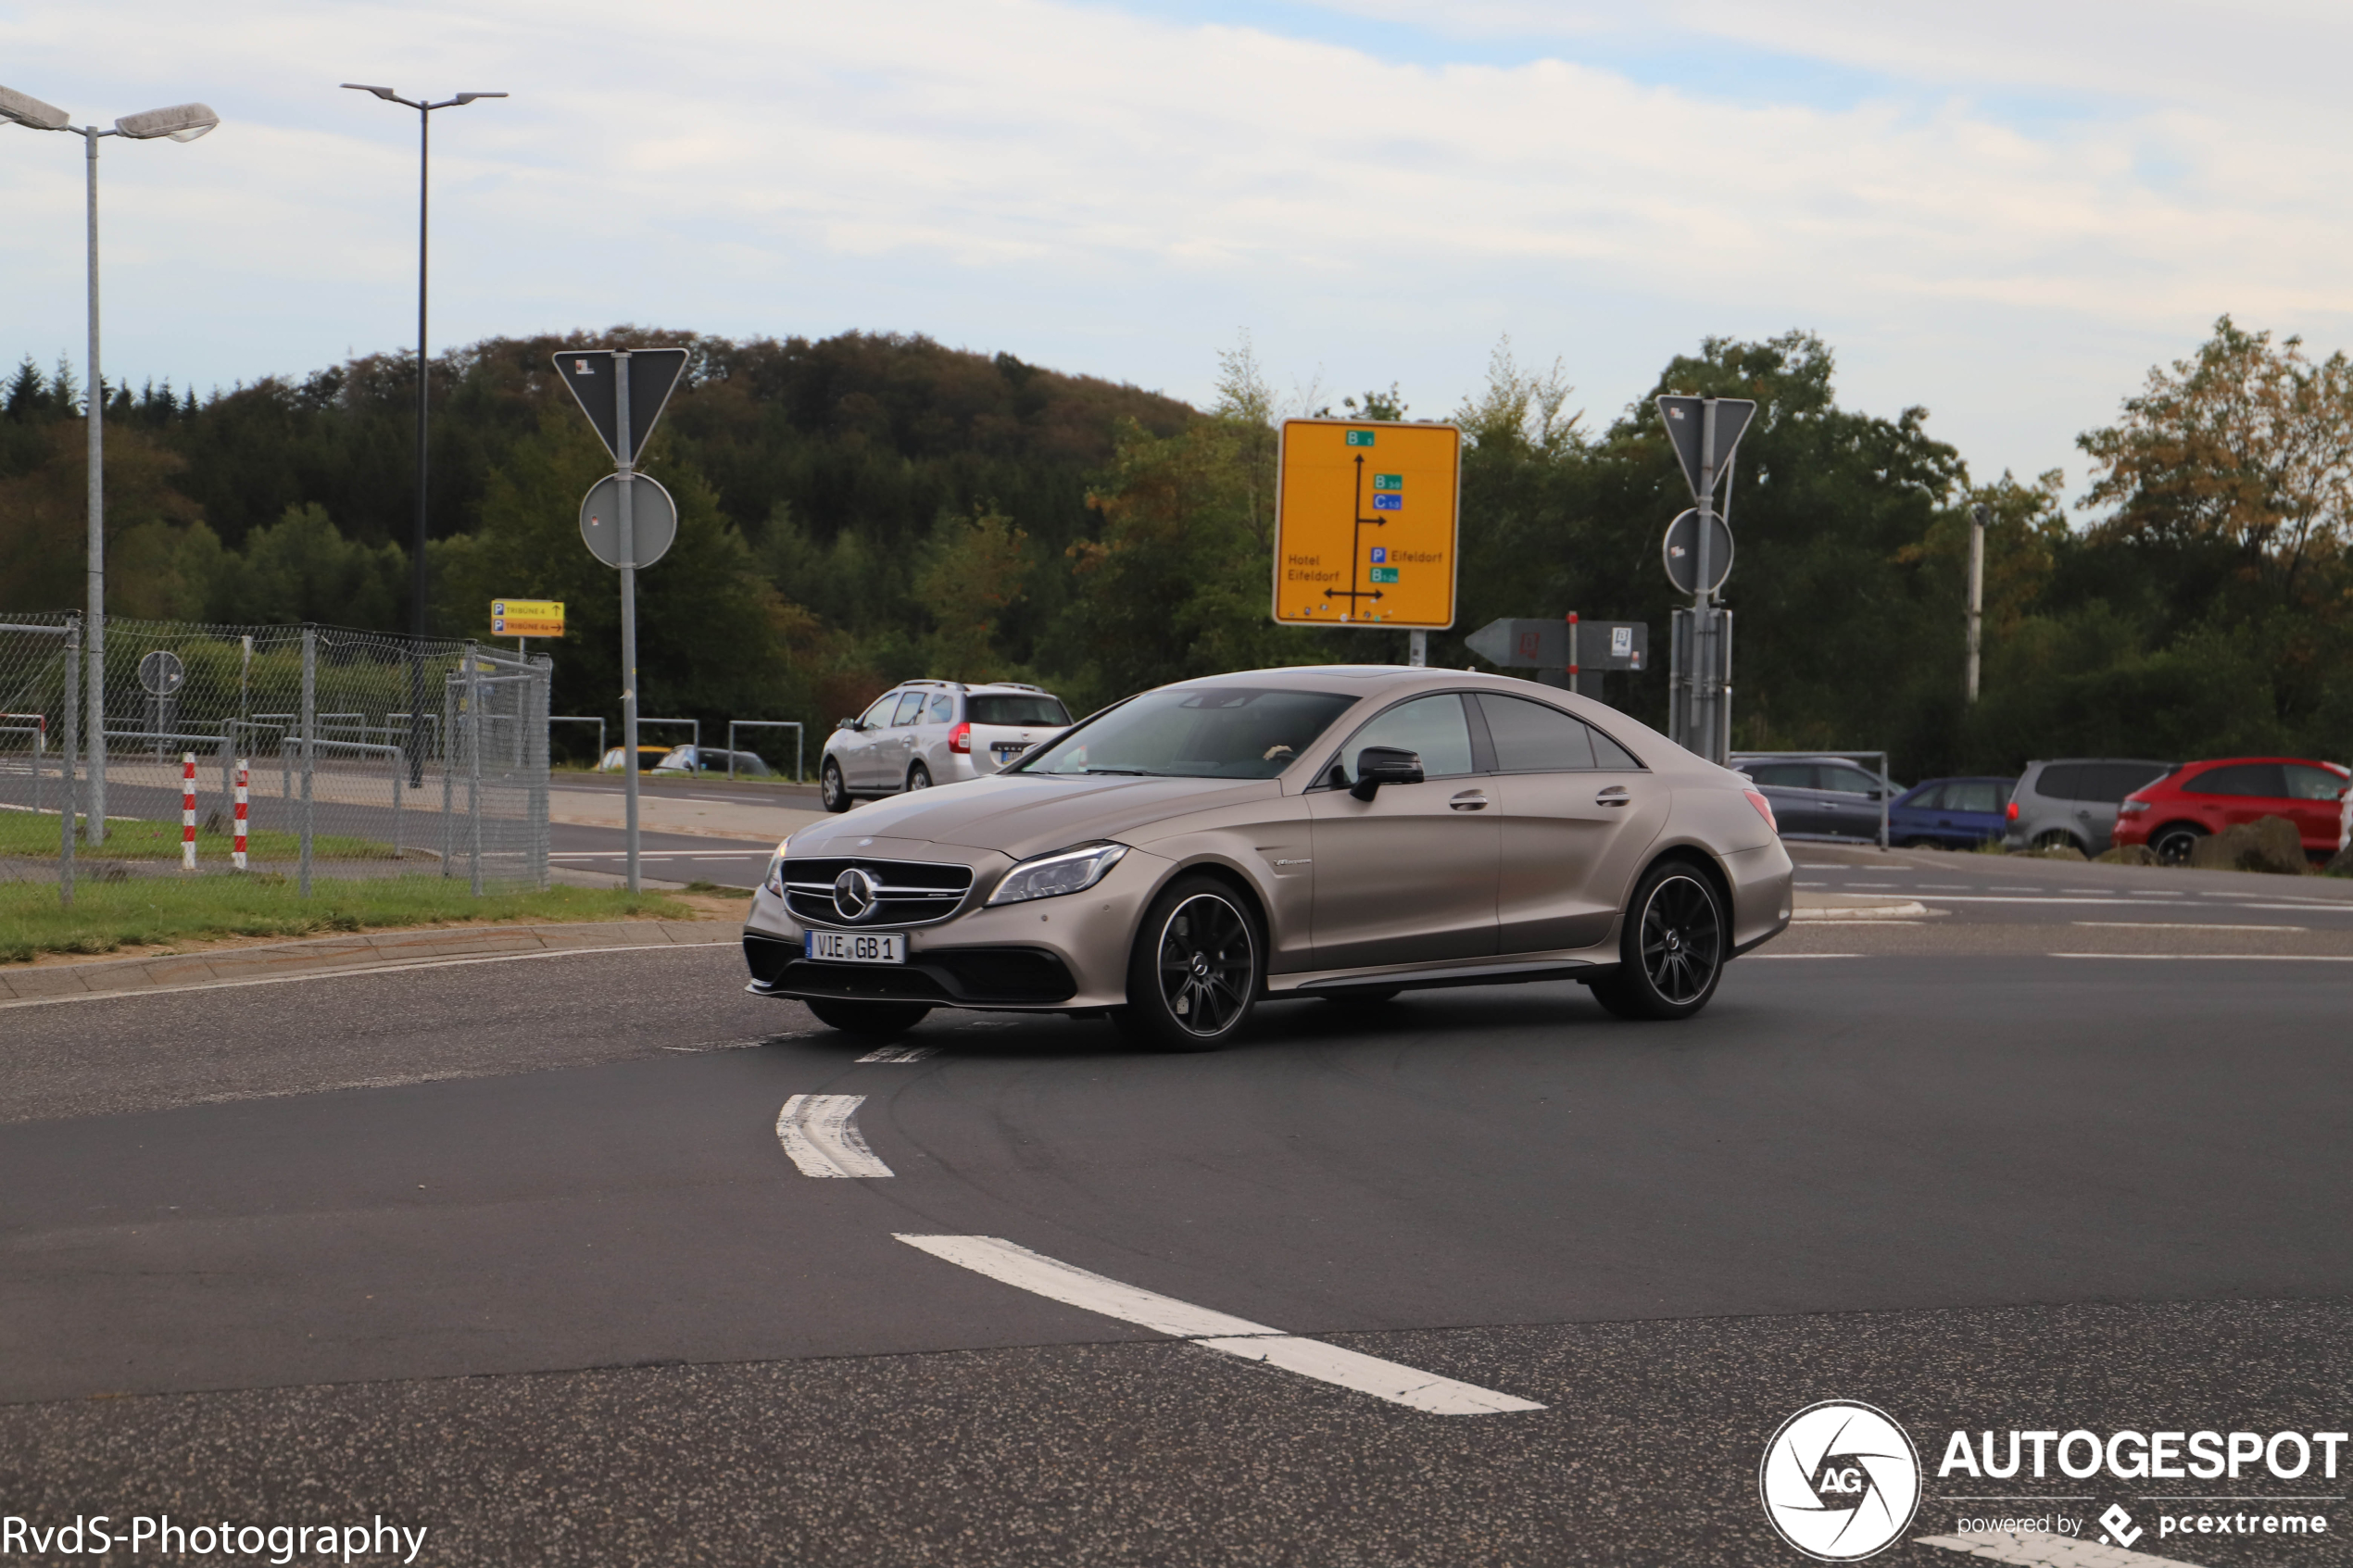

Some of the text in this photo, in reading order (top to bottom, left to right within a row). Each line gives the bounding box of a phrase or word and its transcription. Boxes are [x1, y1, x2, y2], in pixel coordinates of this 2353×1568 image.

[1348, 432, 1358, 445] B
[1376, 475, 1386, 488] B
[1375, 495, 1386, 508] C
[1289, 555, 1320, 566] Hotel
[1373, 548, 1442, 563] P Eifeldorf
[1288, 569, 1340, 582] Eifeldorf
[1372, 568, 1382, 582] B
[496, 604, 503, 614] P
[506, 606, 538, 614] TRIBÜNE
[495, 620, 503, 630] P
[818, 935, 844, 958] VIE
